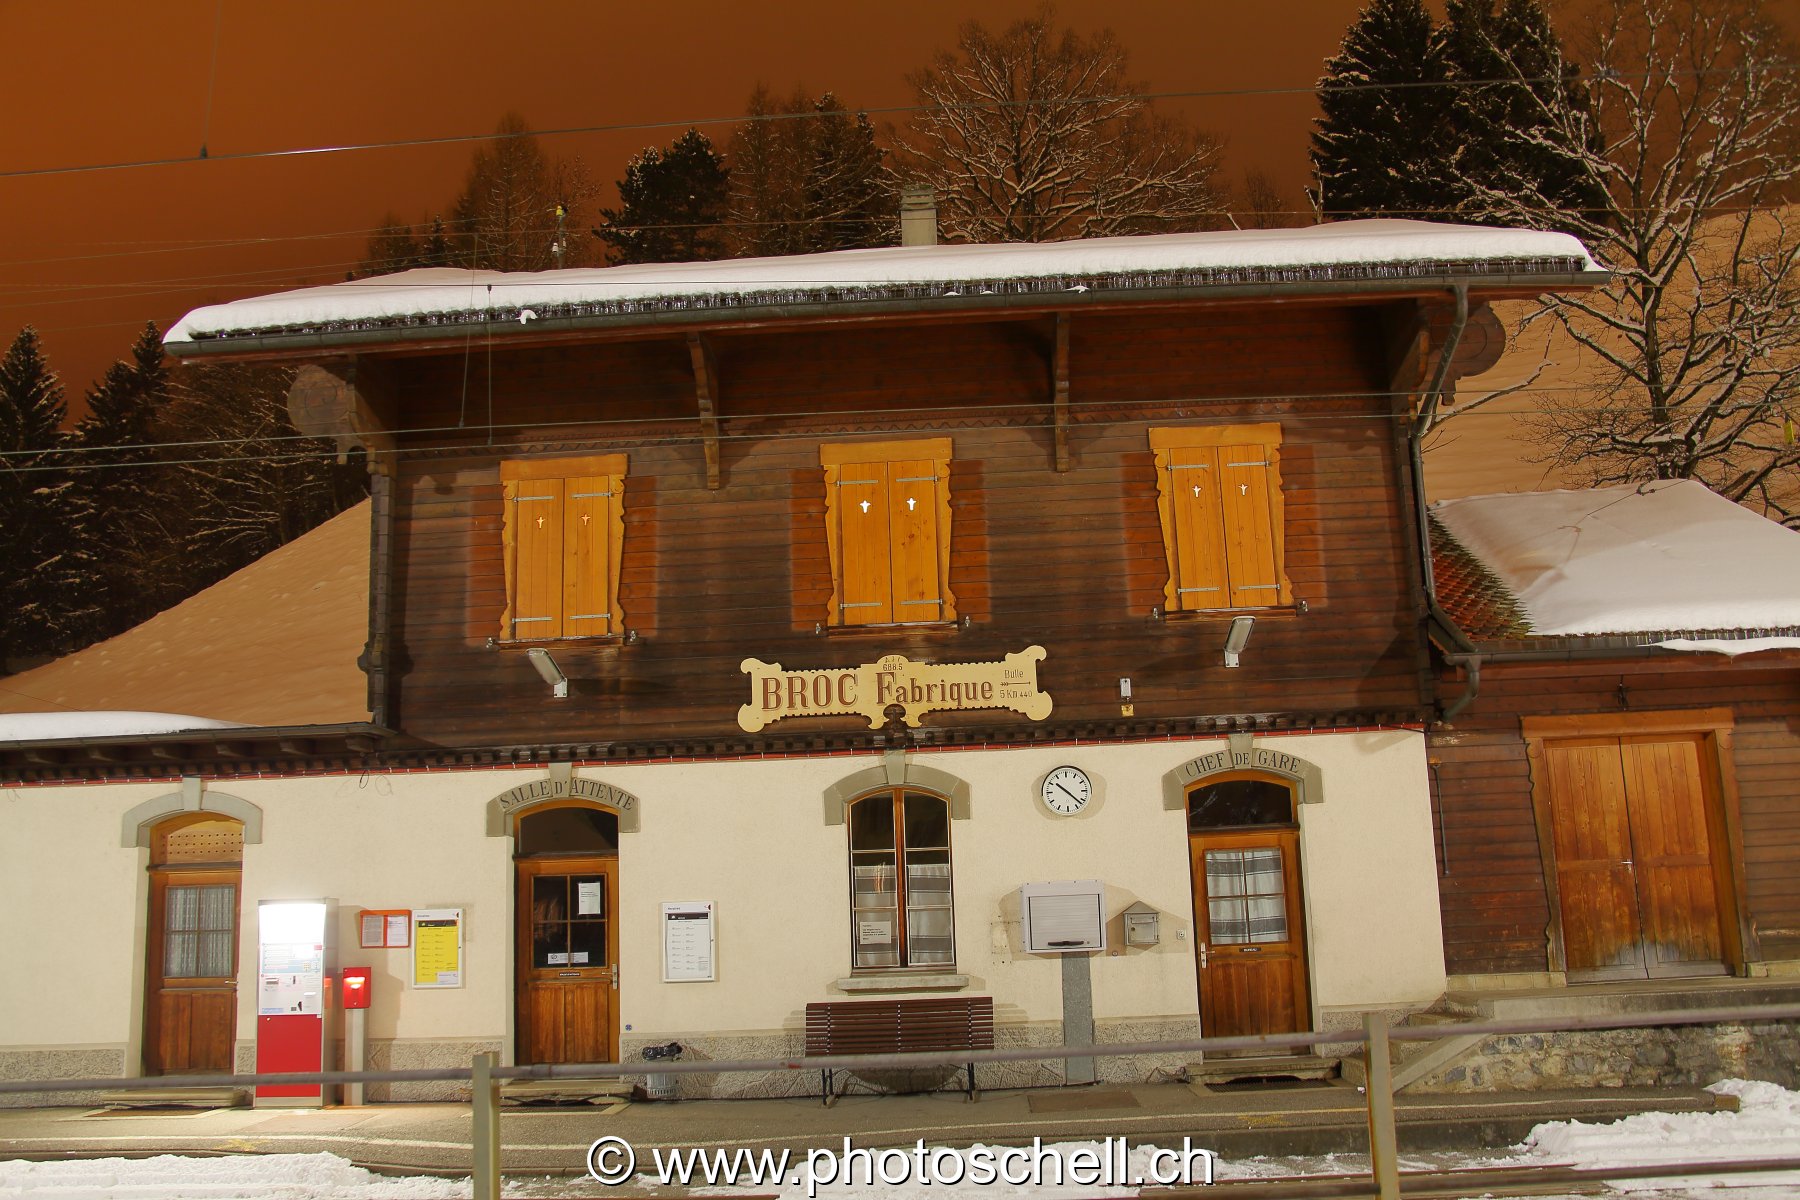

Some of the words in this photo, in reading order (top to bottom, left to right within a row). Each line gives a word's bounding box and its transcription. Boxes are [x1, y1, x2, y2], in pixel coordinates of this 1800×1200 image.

[1004, 669, 1024, 679] Bulle
[761, 673, 858, 711] BROC
[875, 671, 994, 707] Fabrique
[1185, 752, 1225, 777] CHEF
[1235, 752, 1250, 766] DE
[1258, 750, 1301, 774] GARE
[500, 780, 550, 809] SALLE
